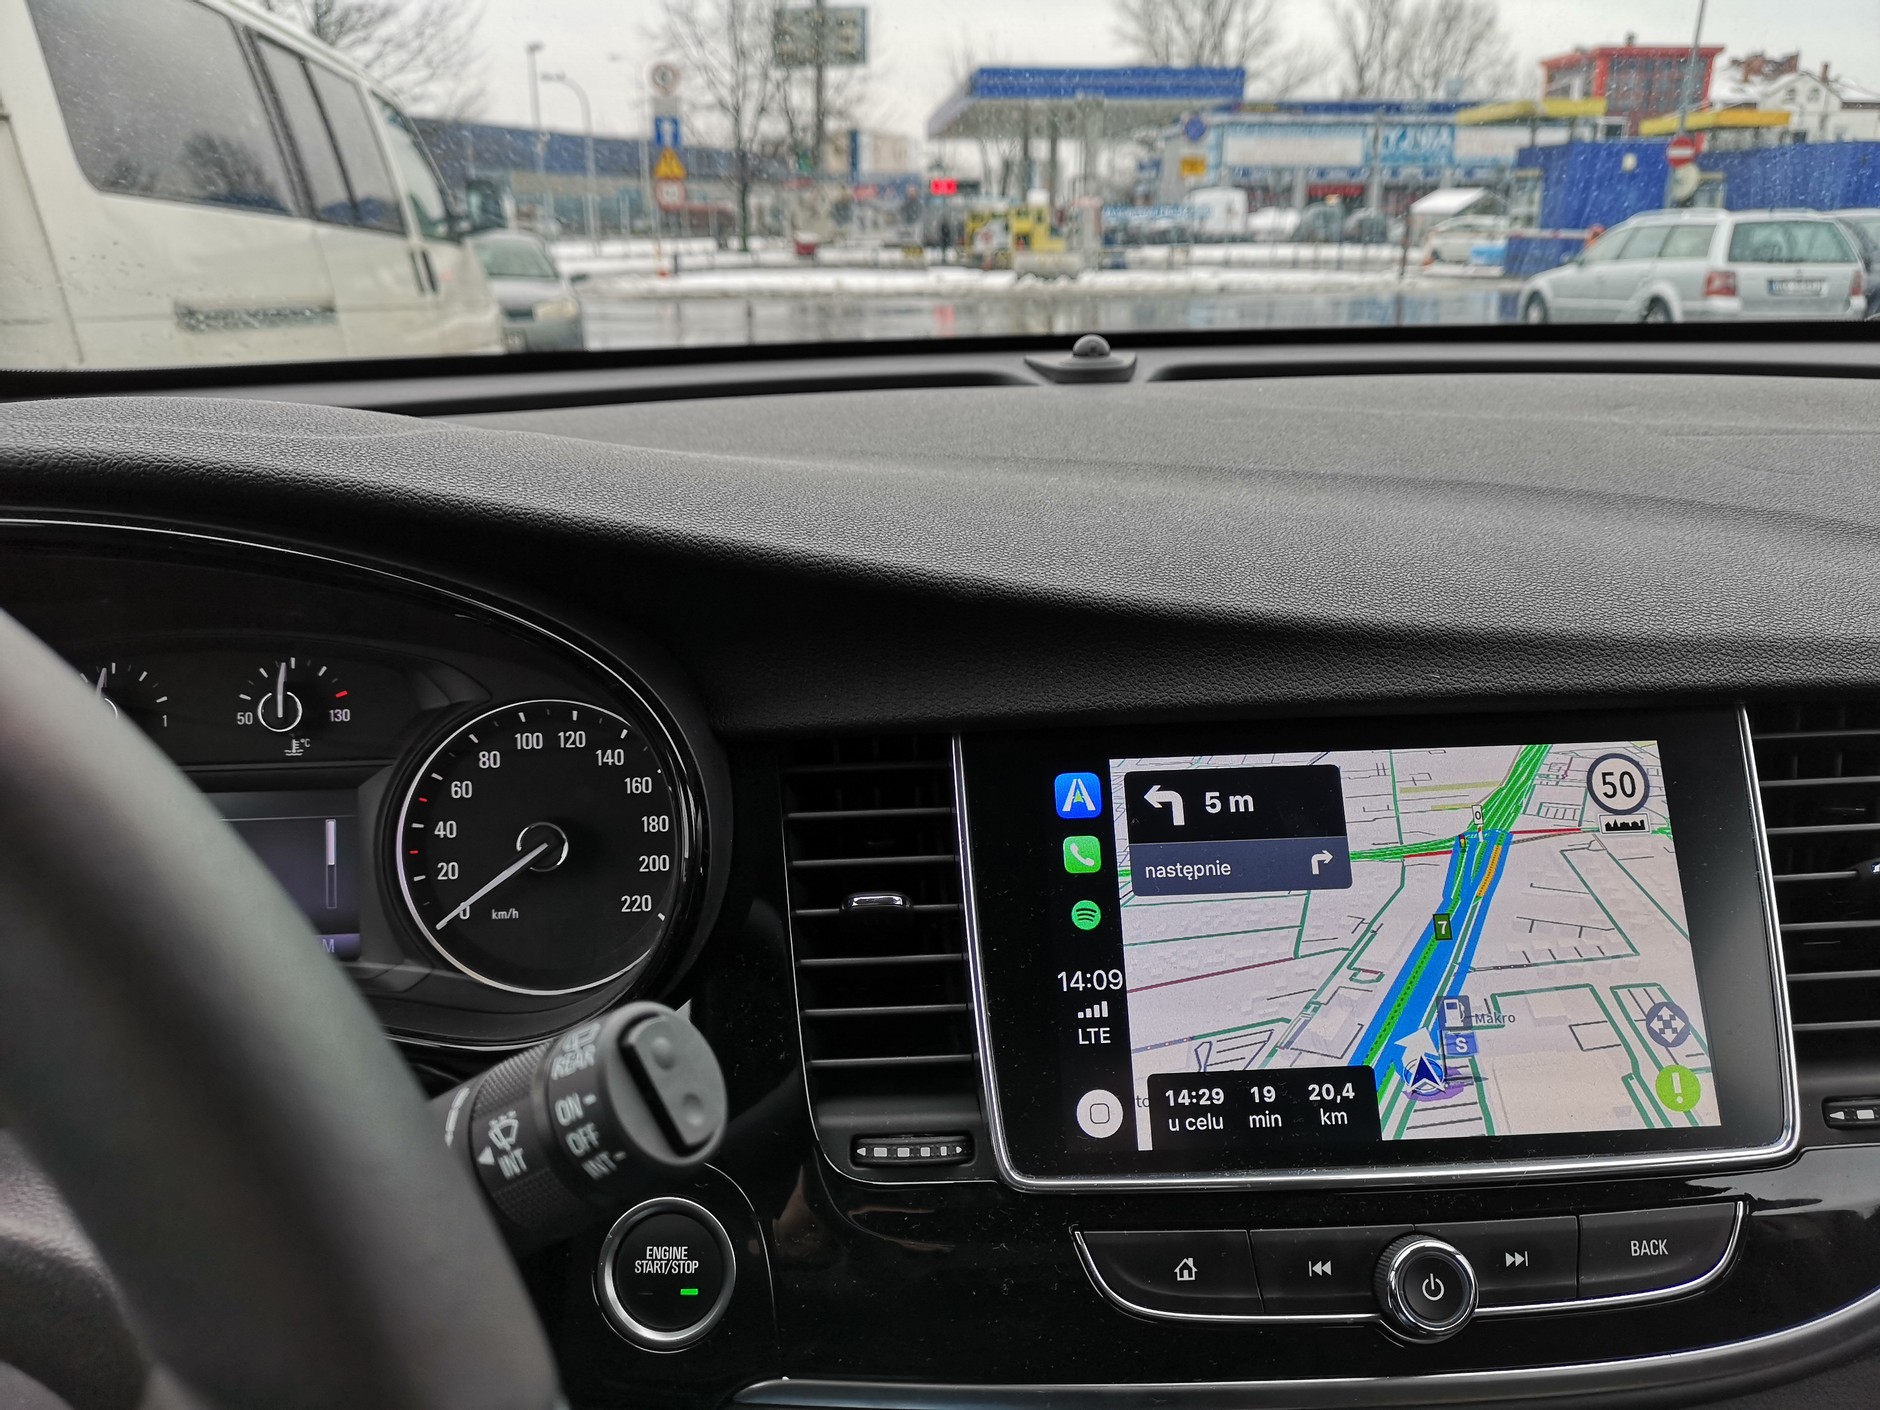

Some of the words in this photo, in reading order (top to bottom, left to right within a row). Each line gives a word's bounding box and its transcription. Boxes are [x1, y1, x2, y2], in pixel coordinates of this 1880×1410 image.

[237, 711, 254, 725] 50
[328, 708, 351, 722] 130
[514, 732, 543, 750] 100
[557, 731, 587, 748] 120
[478, 751, 501, 769] 80
[595, 749, 625, 766] 140
[450, 780, 473, 799] 60
[624, 776, 653, 794] 160
[1601, 770, 1636, 799] 50
[1205, 791, 1222, 814] 5
[1229, 794, 1254, 812] m
[434, 820, 457, 839] 40
[641, 815, 669, 833] 180
[436, 862, 459, 880] 20
[638, 854, 670, 872] 200
[1145, 860, 1231, 880] następnie
[620, 894, 652, 913] 220
[491, 908, 519, 920] km/h
[1437, 920, 1448, 935] 7
[1057, 969, 1123, 992] 14:09
[1475, 1012, 1516, 1025] Makro
[1078, 1027, 1111, 1045] LTE
[1455, 1037, 1468, 1053] S
[551, 1045, 596, 1080] REAR
[1165, 1087, 1225, 1107] 14:29
[1250, 1085, 1276, 1103] 19
[1307, 1082, 1355, 1103] 20,4
[554, 1093, 584, 1127] ON
[1320, 1108, 1348, 1126] km
[1168, 1118, 1180, 1132] u
[1185, 1112, 1224, 1131] celu
[1249, 1110, 1282, 1129] min
[565, 1122, 600, 1157] OFF
[498, 1148, 527, 1180] INT
[646, 1246, 688, 1260] ENGINE
[1630, 1239, 1669, 1257] BACK
[634, 1260, 699, 1275] START/STOP
